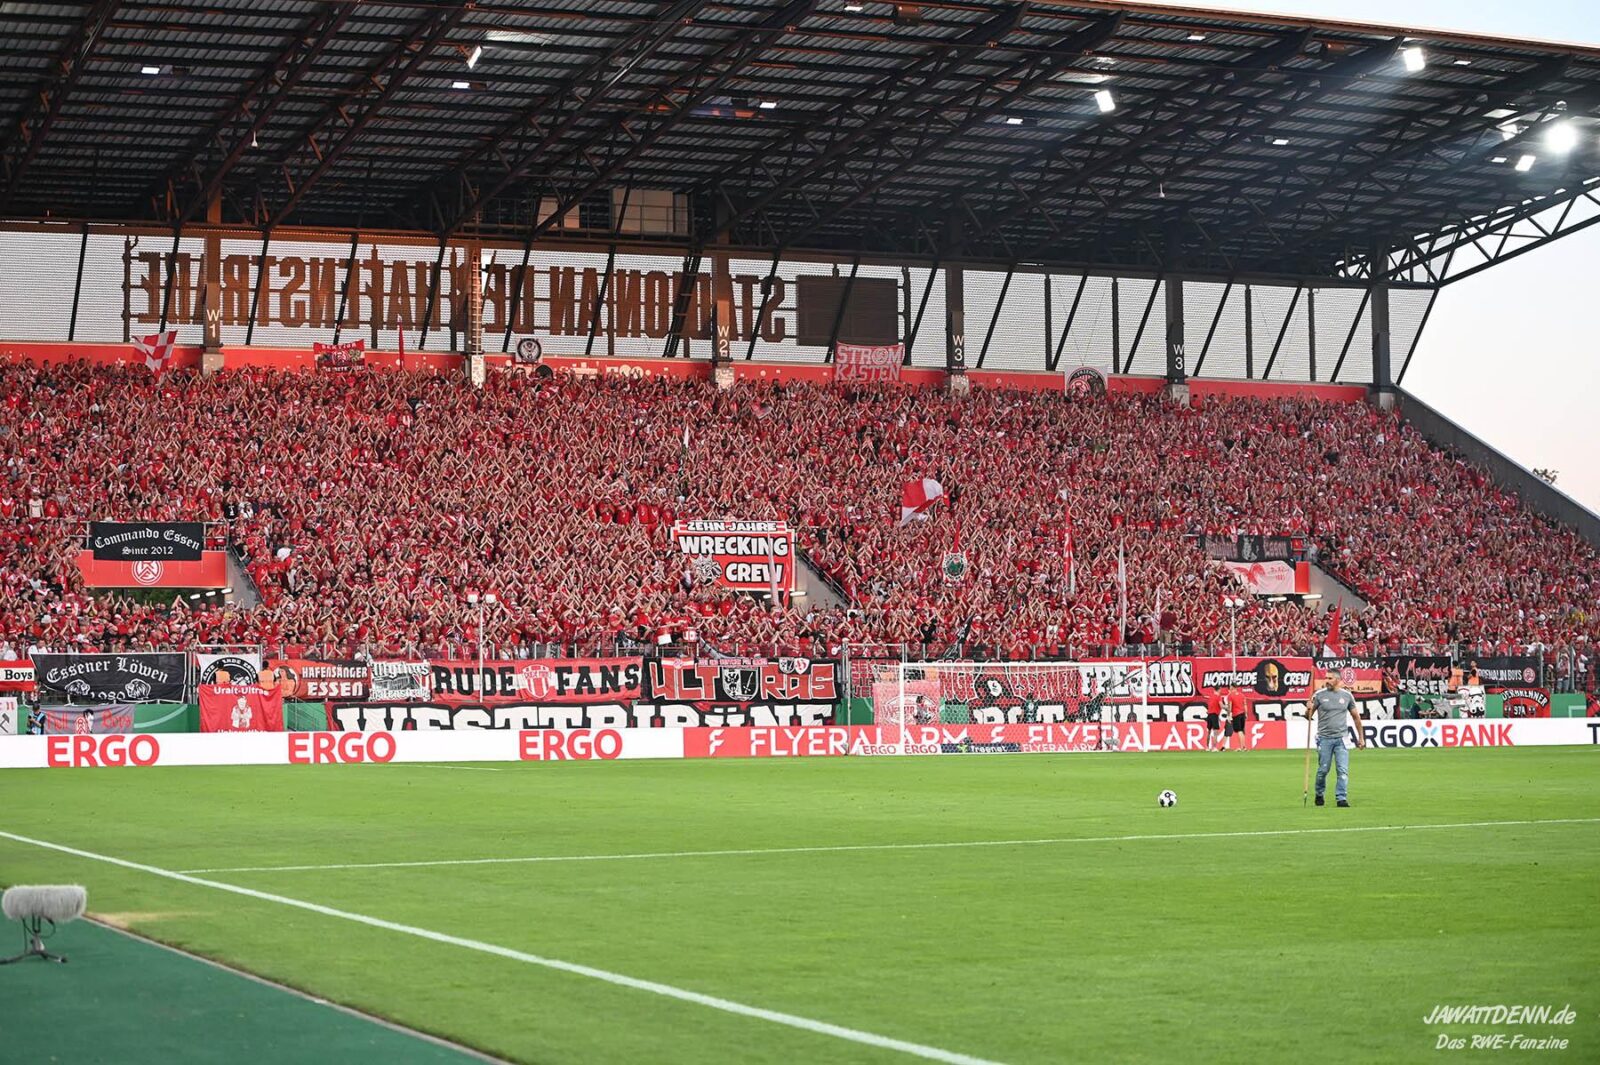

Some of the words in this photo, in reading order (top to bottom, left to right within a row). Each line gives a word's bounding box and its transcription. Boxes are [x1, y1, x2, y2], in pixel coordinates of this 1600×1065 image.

[94, 527, 160, 549] Commando
[163, 529, 200, 550] Essen
[678, 535, 788, 556] WRECKING
[121, 546, 149, 555] Since
[150, 546, 174, 555] 2012
[724, 562, 783, 583] CREW
[4, 669, 33, 681] Boys
[46, 659, 111, 683] Essener
[116, 656, 168, 683] Löwen
[302, 663, 368, 679] HAFENSÄNGER
[432, 665, 516, 696] RUDE
[555, 664, 642, 696] FANS
[1283, 672, 1310, 686] CREW
[307, 681, 363, 697] ESSEN
[518, 729, 622, 761] ERGO
[1345, 724, 1418, 748] ARGO
[1441, 723, 1515, 747] BANK
[47, 735, 160, 768] ERGO
[287, 731, 397, 765] ERGO
[863, 745, 897, 755] ERGO
[904, 744, 938, 755] ERGO
